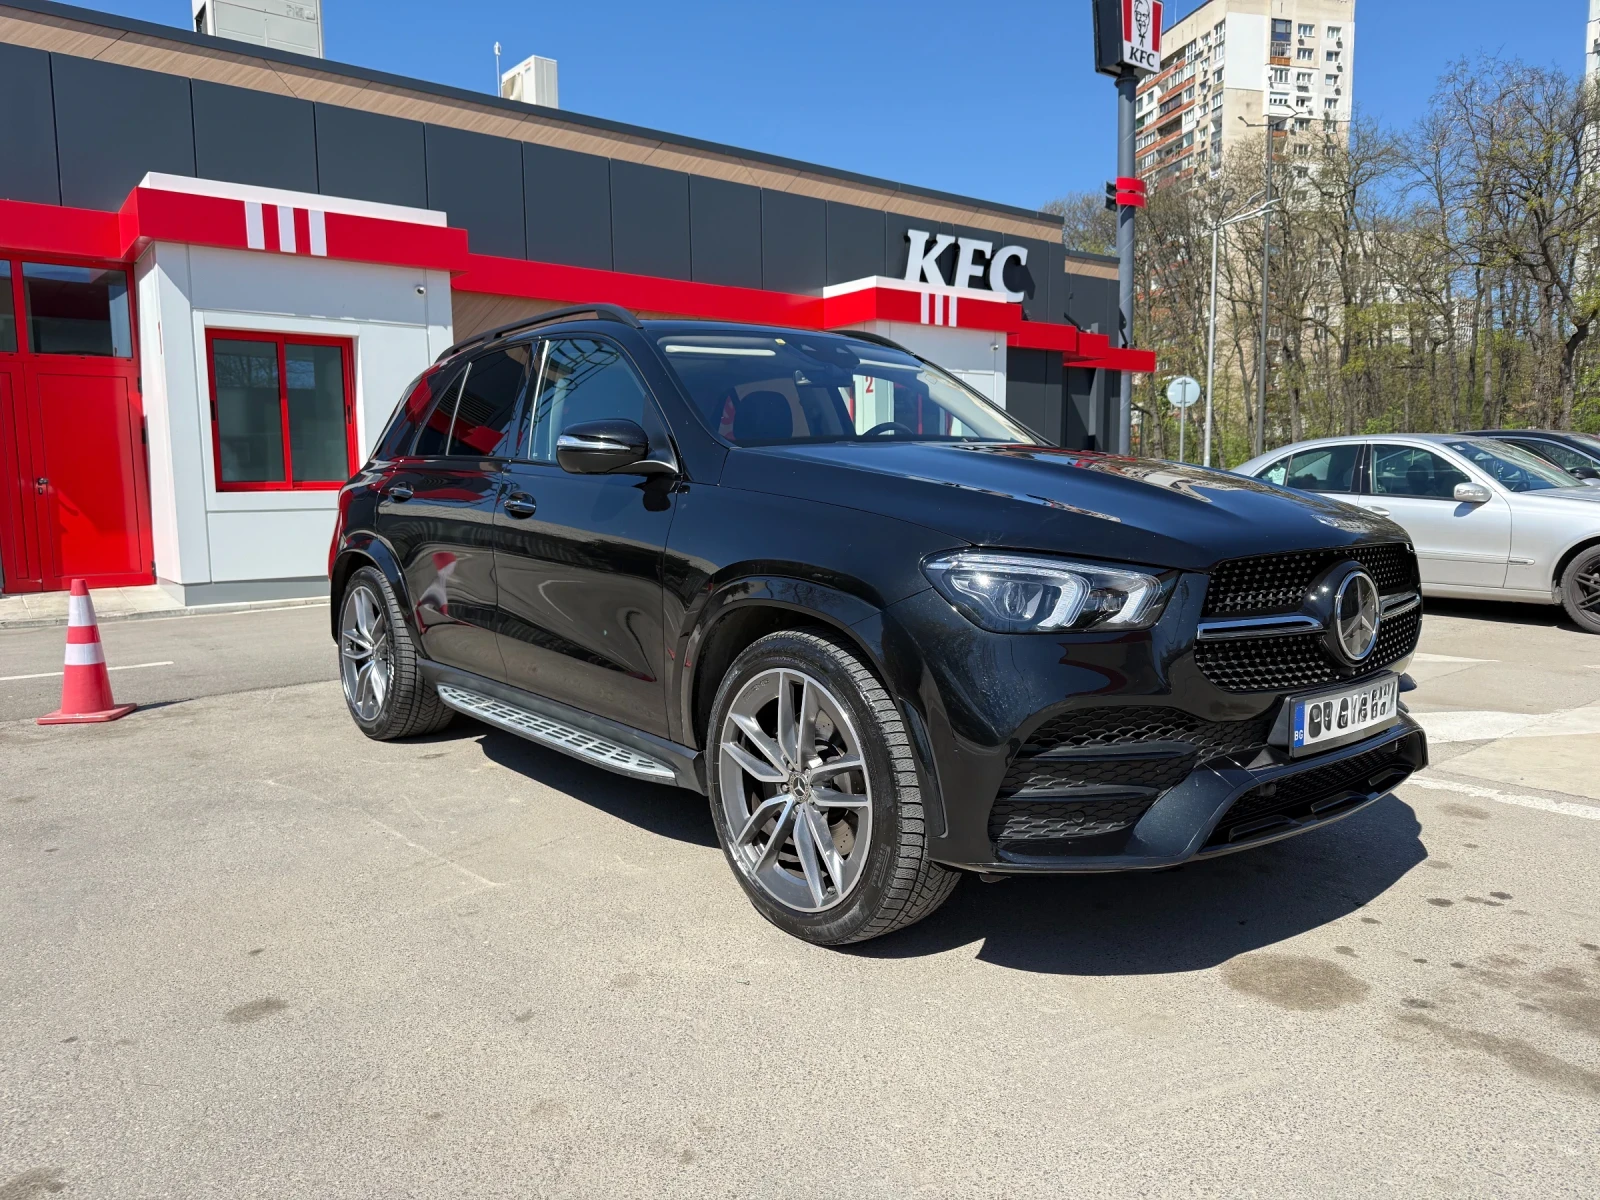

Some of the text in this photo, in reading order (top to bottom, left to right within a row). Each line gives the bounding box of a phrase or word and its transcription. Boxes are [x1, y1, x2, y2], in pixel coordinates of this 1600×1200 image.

[1129, 46, 1155, 68] KFC
[904, 229, 1029, 303] KFC
[1294, 729, 1304, 741] BG
